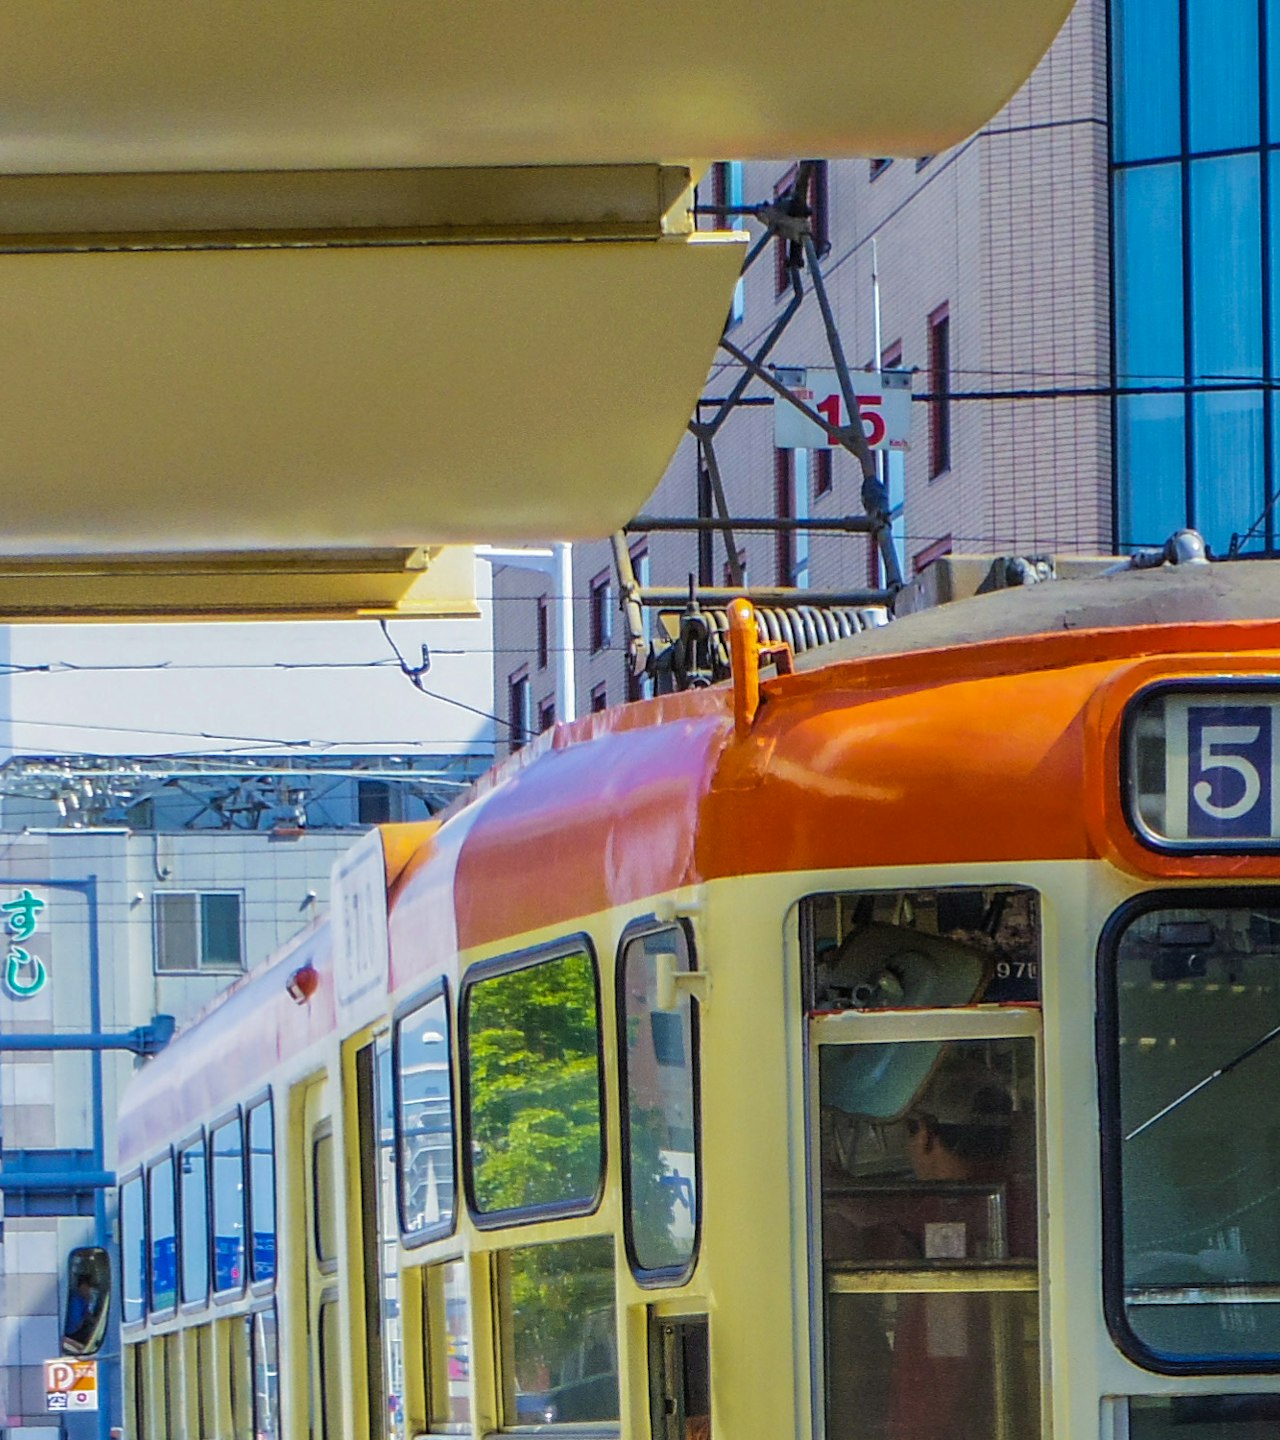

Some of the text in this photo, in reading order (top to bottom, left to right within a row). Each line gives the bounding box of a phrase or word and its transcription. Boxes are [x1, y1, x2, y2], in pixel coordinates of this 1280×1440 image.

[817, 394, 886, 446] 15
[1190, 725, 1263, 820] 5
[0, 888, 47, 996] すし
[48, 1363, 74, 1388] P
